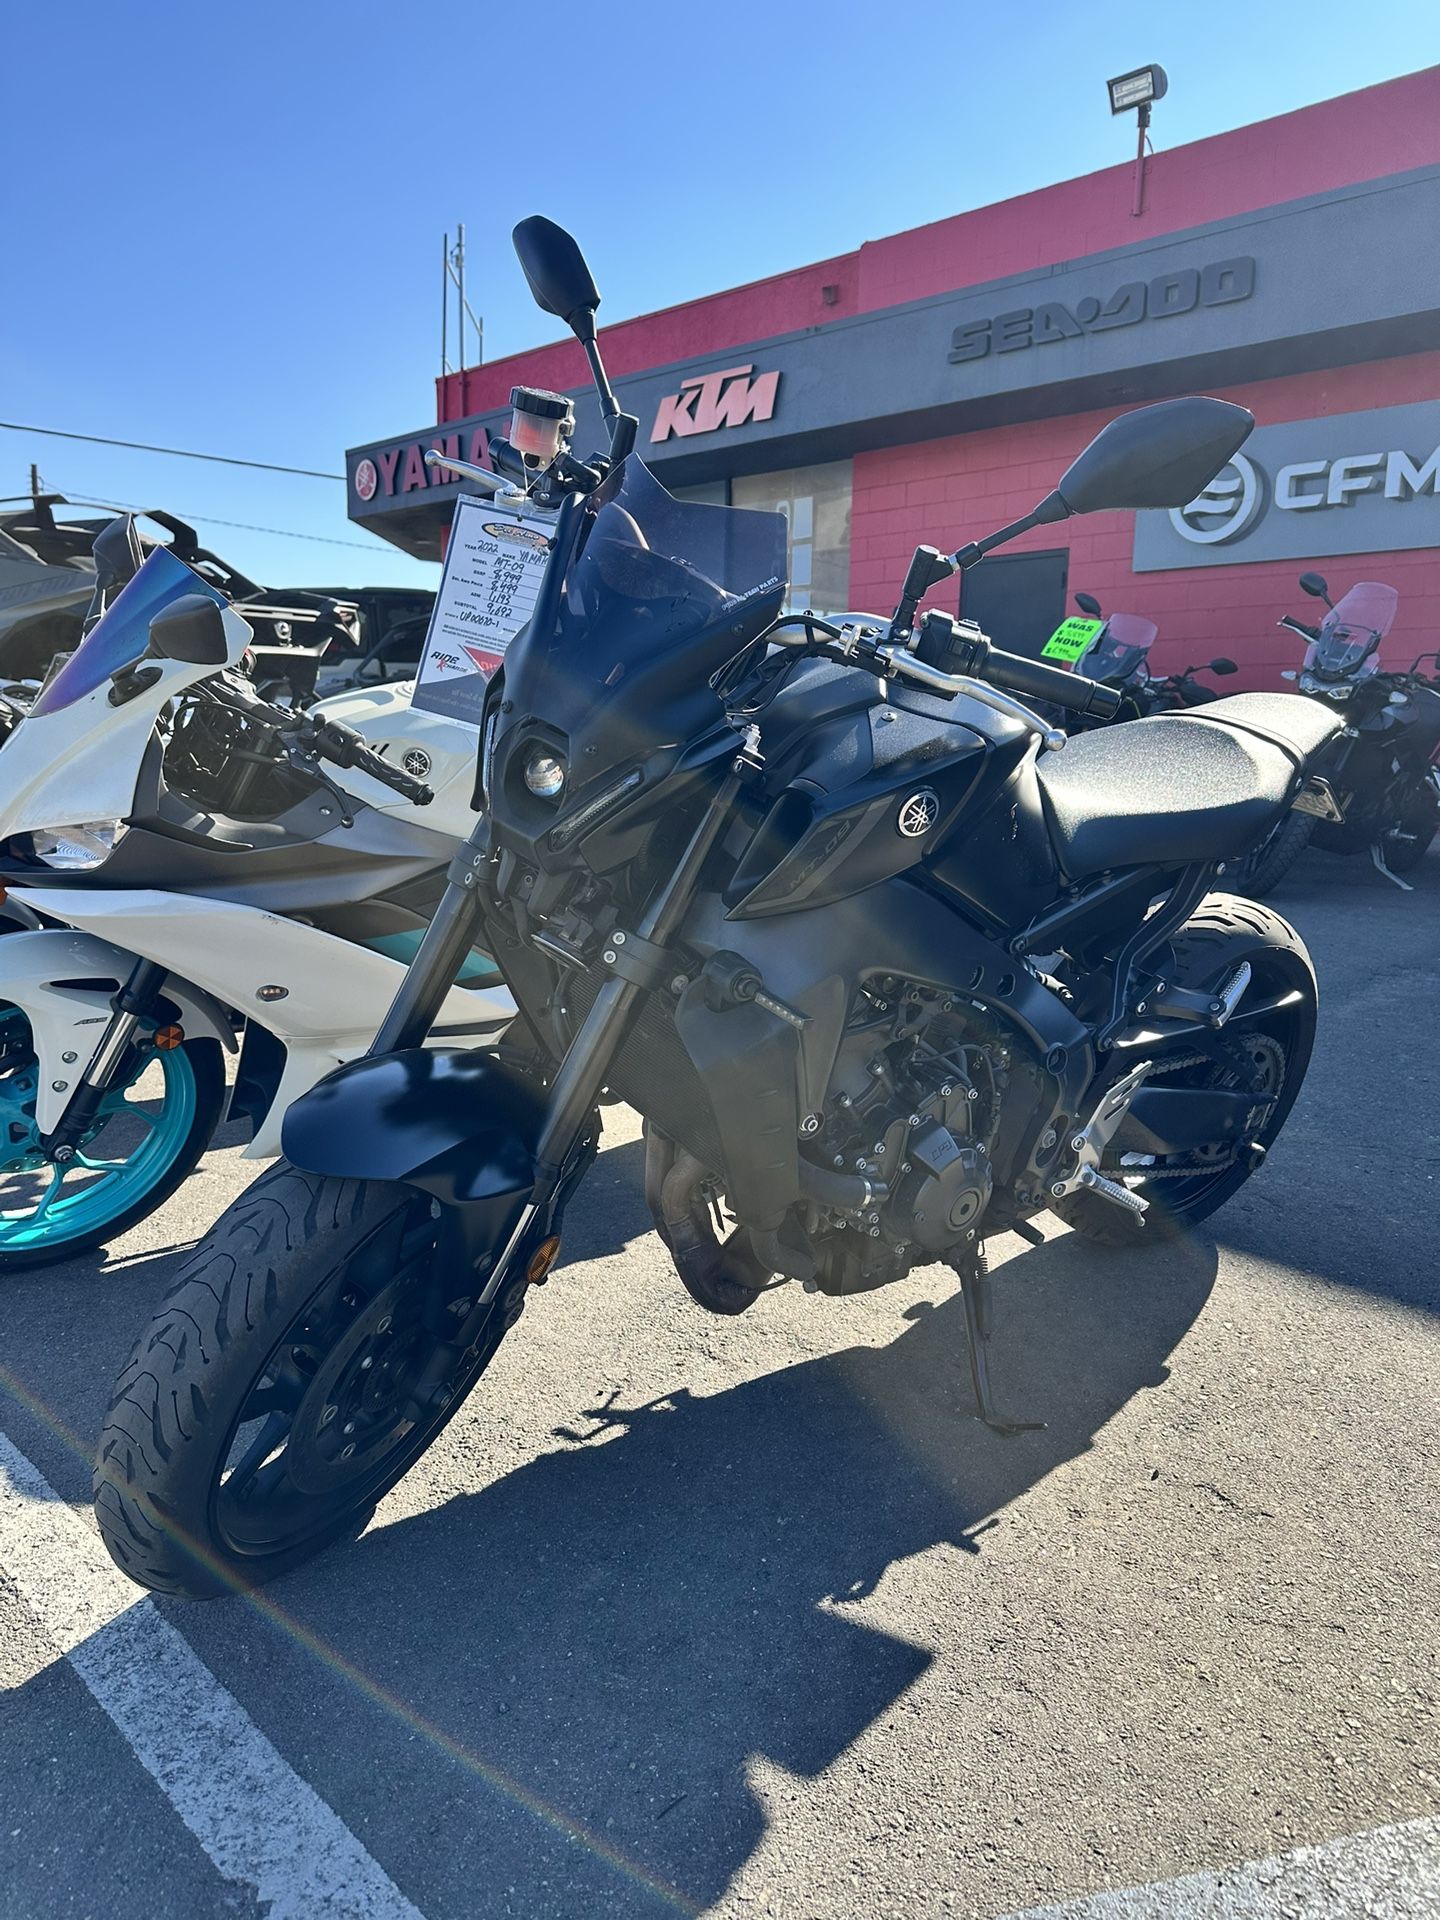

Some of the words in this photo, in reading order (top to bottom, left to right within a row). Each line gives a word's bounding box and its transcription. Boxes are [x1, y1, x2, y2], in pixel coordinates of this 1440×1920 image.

[650, 363, 780, 443] KTM
[464, 543, 477, 551] YEAR
[477, 539, 499, 553] 2022
[472, 558, 488, 566] MODEL
[494, 556, 525, 573] MT-09
[493, 569, 522, 584] 8,999
[759, 575, 779, 590] PARTS
[490, 580, 519, 595] 8,499
[454, 600, 477, 611] SUBTOTAL
[486, 602, 513, 618] 9,692
[1067, 622, 1095, 632] WAS
[1054, 636, 1084, 648] NOW
[430, 650, 460, 665] RIDE
